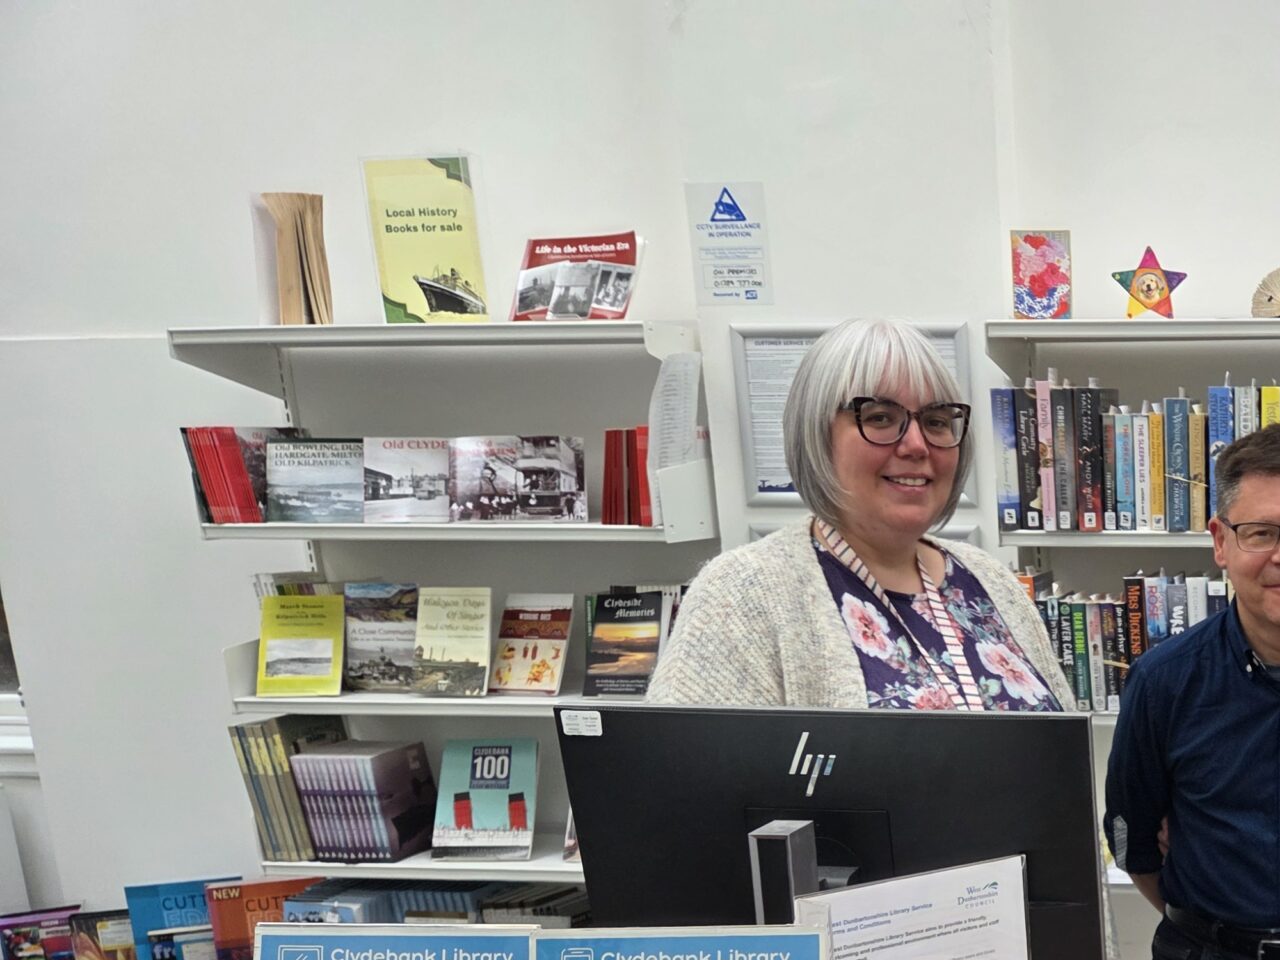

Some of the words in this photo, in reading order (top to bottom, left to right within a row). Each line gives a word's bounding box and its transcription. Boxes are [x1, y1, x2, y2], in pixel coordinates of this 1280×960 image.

[386, 208, 415, 218] Local
[418, 208, 457, 218] History
[385, 224, 418, 233] Books
[422, 223, 436, 232] for
[440, 222, 462, 232] sale
[536, 245, 550, 253] Life
[553, 245, 561, 253] in
[563, 245, 577, 253] the
[578, 244, 614, 252] Victorian
[616, 242, 630, 250] Era
[1081, 416, 1089, 441] MARY
[382, 440, 404, 450] Old
[408, 440, 448, 449] CLYDE
[604, 599, 642, 608] Clydeside
[1128, 586, 1140, 609] MRS
[1148, 586, 1158, 620] ROSE
[614, 608, 655, 618] Memories
[1074, 612, 1084, 629] DEAR
[1061, 616, 1072, 641] LAYER
[1129, 612, 1142, 654] DICKENS
[1075, 631, 1085, 654] DEBBIE
[1063, 643, 1073, 666] CAKE
[474, 757, 508, 778] 100
[789, 732, 836, 796] hp
[212, 888, 240, 900] NEW
